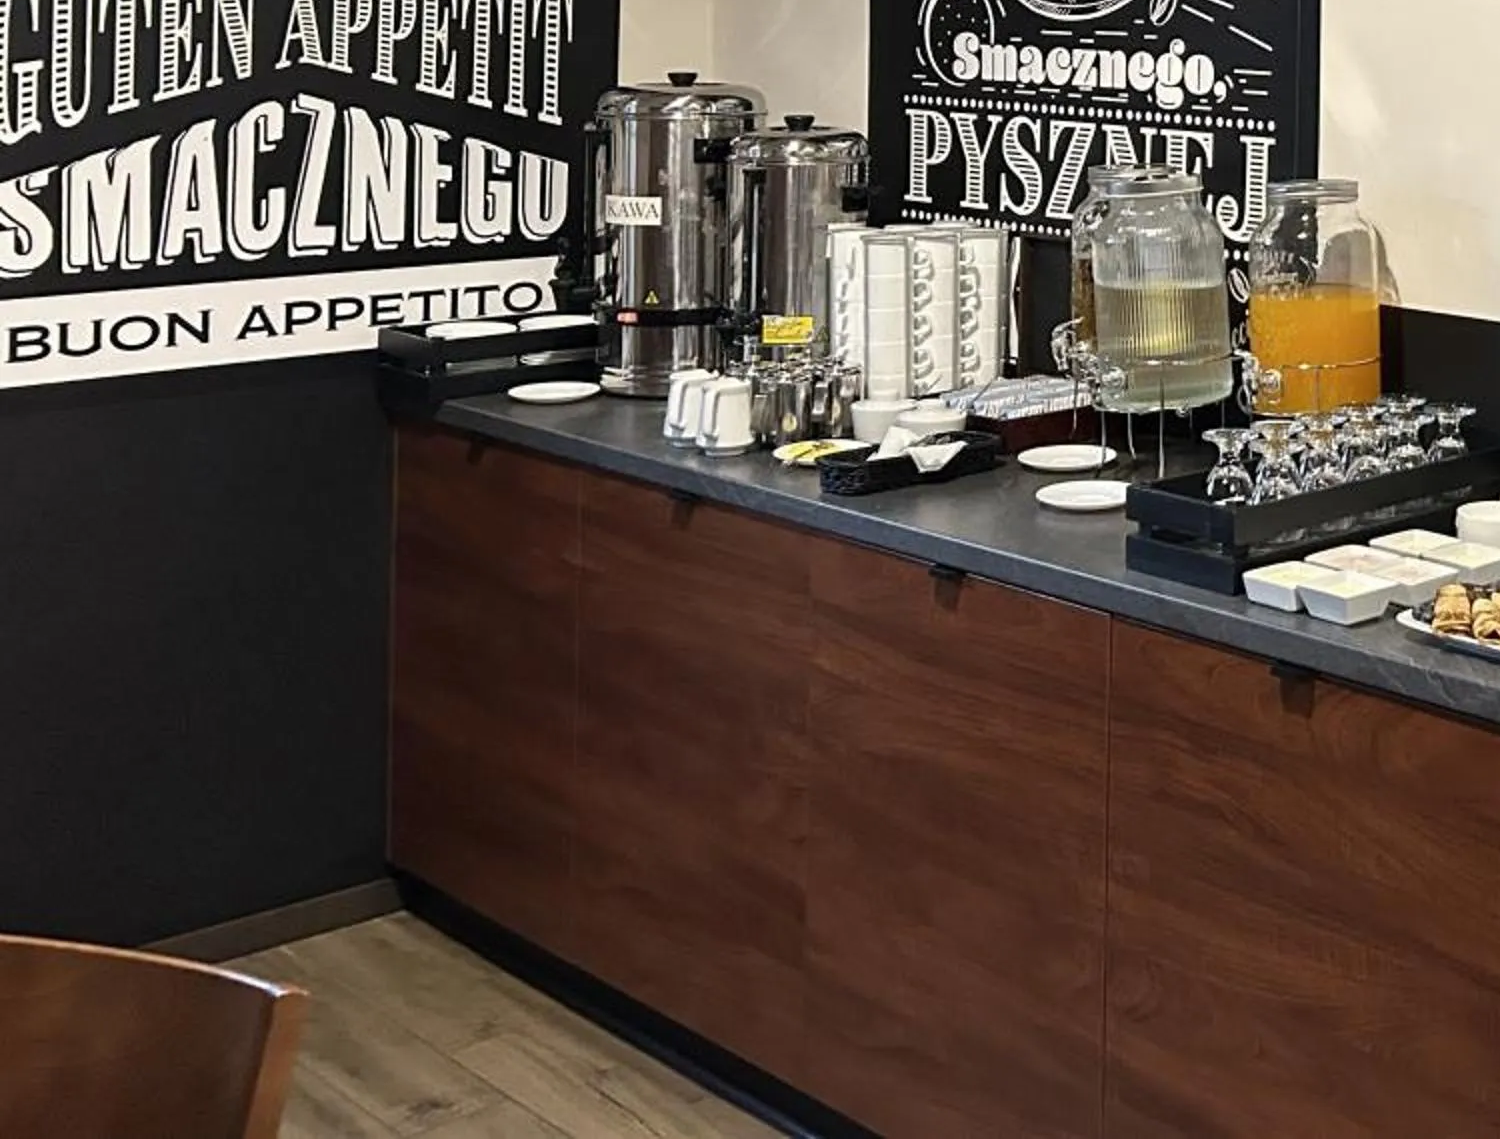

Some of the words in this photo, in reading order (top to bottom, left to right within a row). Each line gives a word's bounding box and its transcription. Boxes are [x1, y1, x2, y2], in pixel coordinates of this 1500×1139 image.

[952, 31, 1228, 110] Smacznego,
[7, 309, 211, 363] BUON
[236, 280, 544, 341] APPETITO
